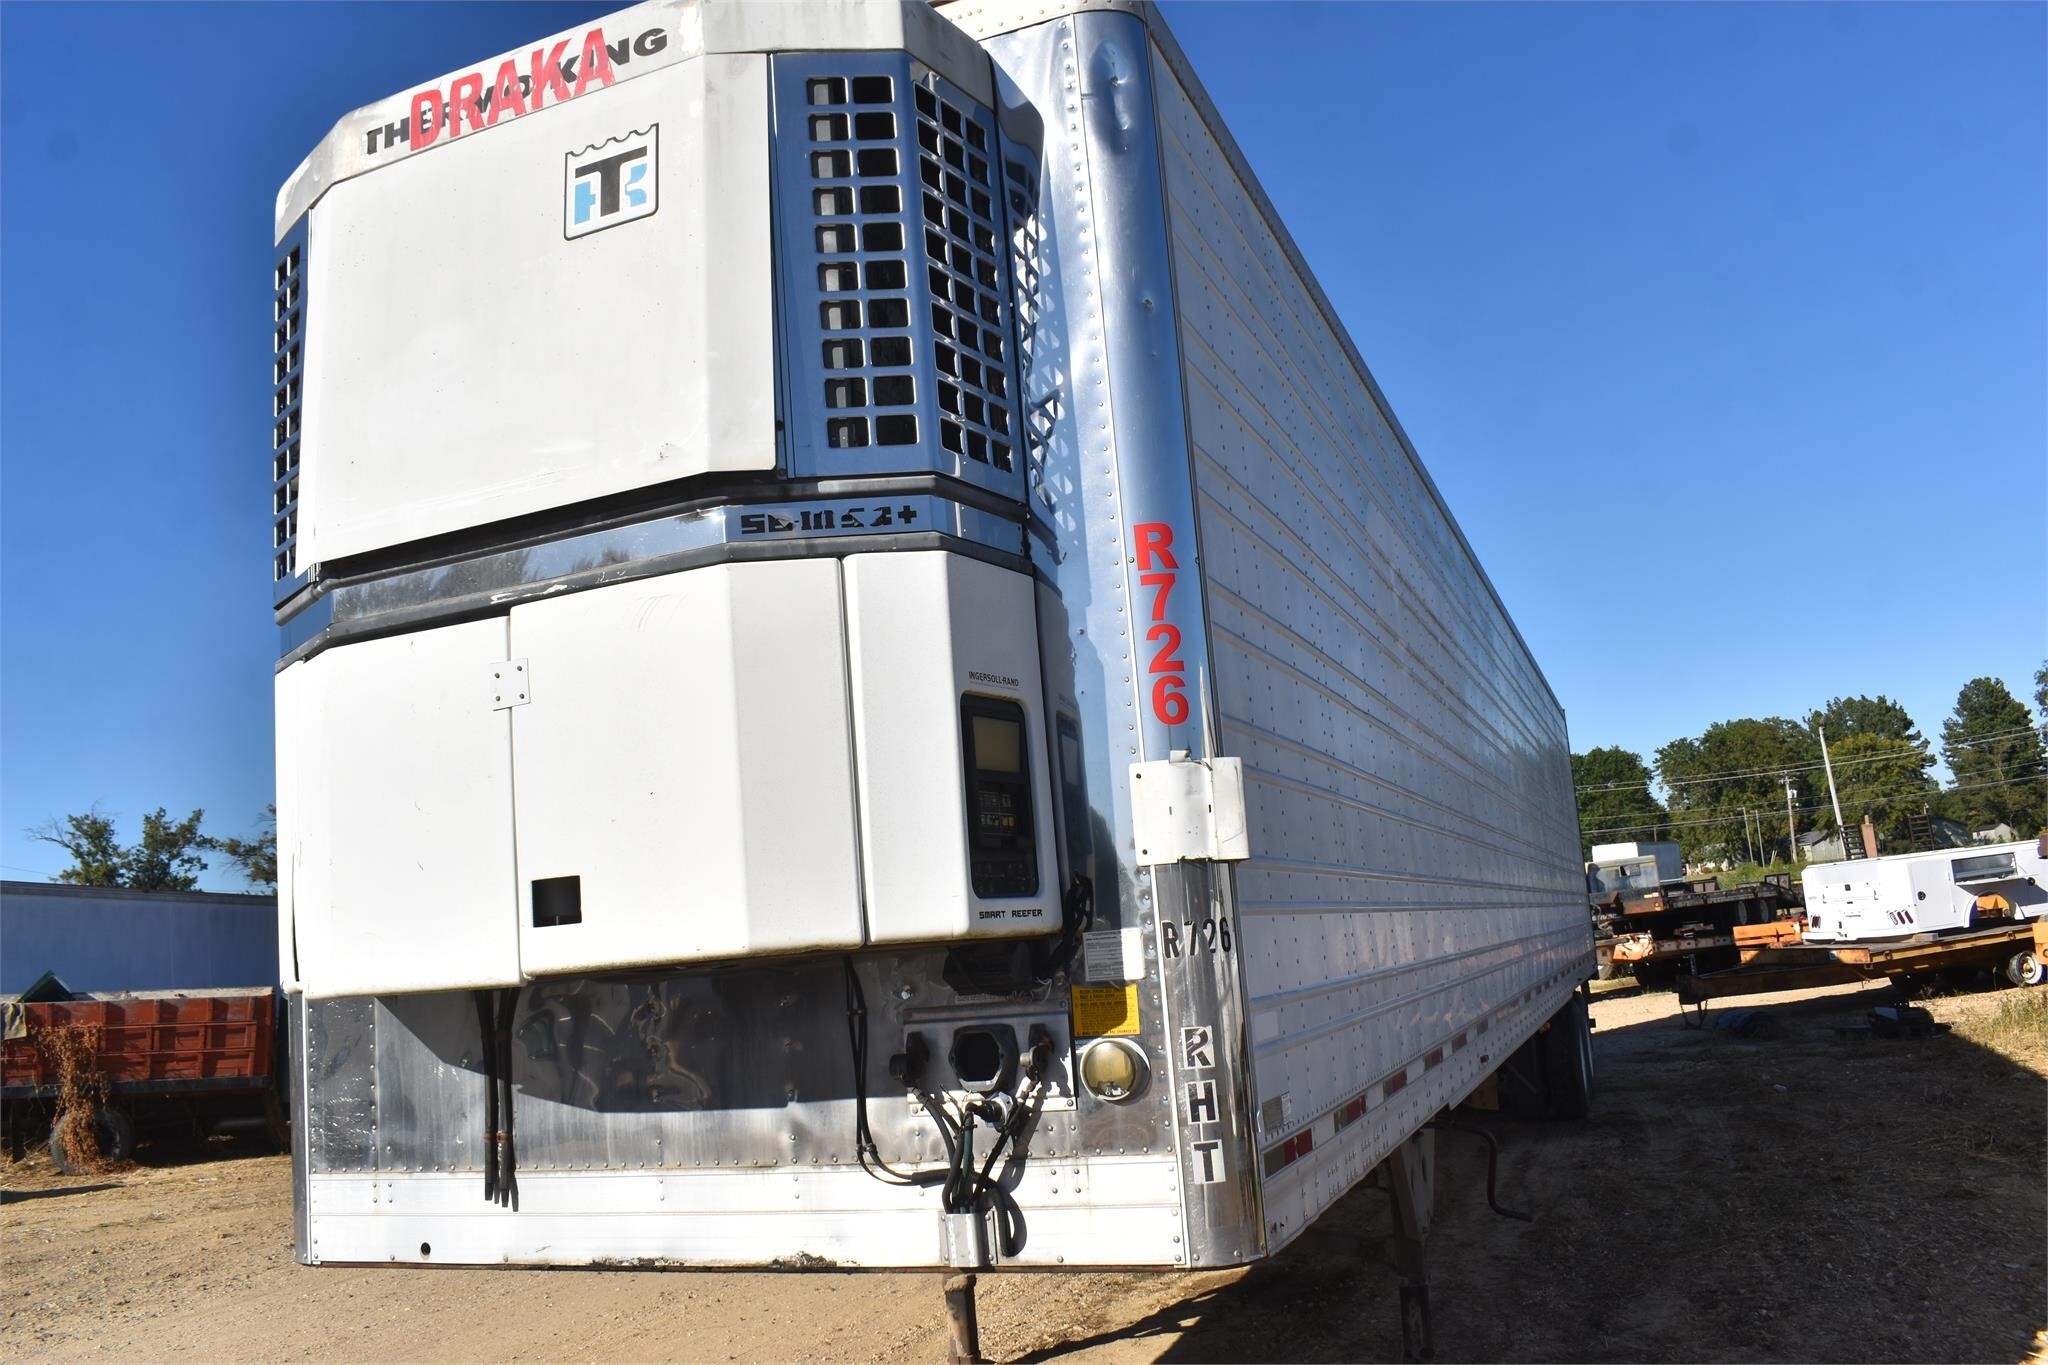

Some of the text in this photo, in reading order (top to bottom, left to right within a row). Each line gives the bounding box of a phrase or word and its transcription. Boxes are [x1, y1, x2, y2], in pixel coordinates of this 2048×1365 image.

[410, 27, 616, 151] DRAKA
[1133, 522, 1190, 725] R726
[968, 671, 1020, 687] INGERSOLL-RAND
[979, 909, 1043, 919] SMART REEFER
[1161, 917, 1232, 958] R726
